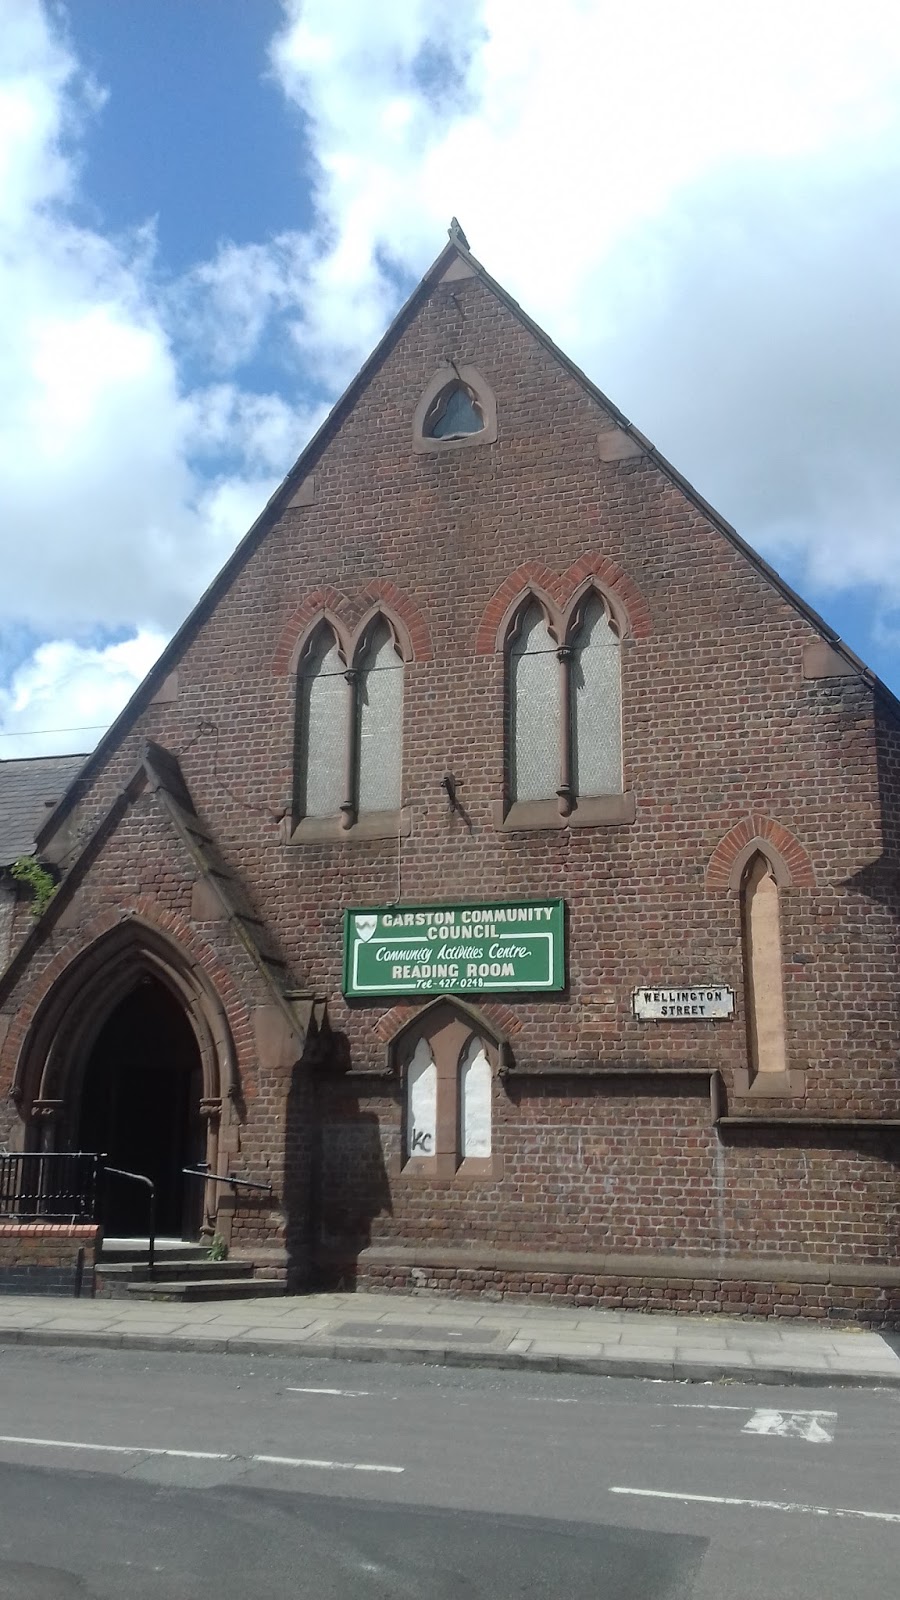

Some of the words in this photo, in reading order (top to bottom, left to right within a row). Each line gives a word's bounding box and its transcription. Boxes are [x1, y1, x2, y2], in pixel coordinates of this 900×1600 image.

[382, 911, 455, 927] GARSTON
[461, 907, 554, 923] COMMUNITY
[427, 924, 500, 940] COUNCIL
[375, 946, 433, 964] Community
[437, 943, 484, 960] Activities
[488, 942, 532, 959] Centre
[392, 964, 459, 979] READING
[466, 962, 515, 977] ROOM
[644, 991, 722, 1003] WELLINGTON
[661, 1005, 706, 1016] STREET
